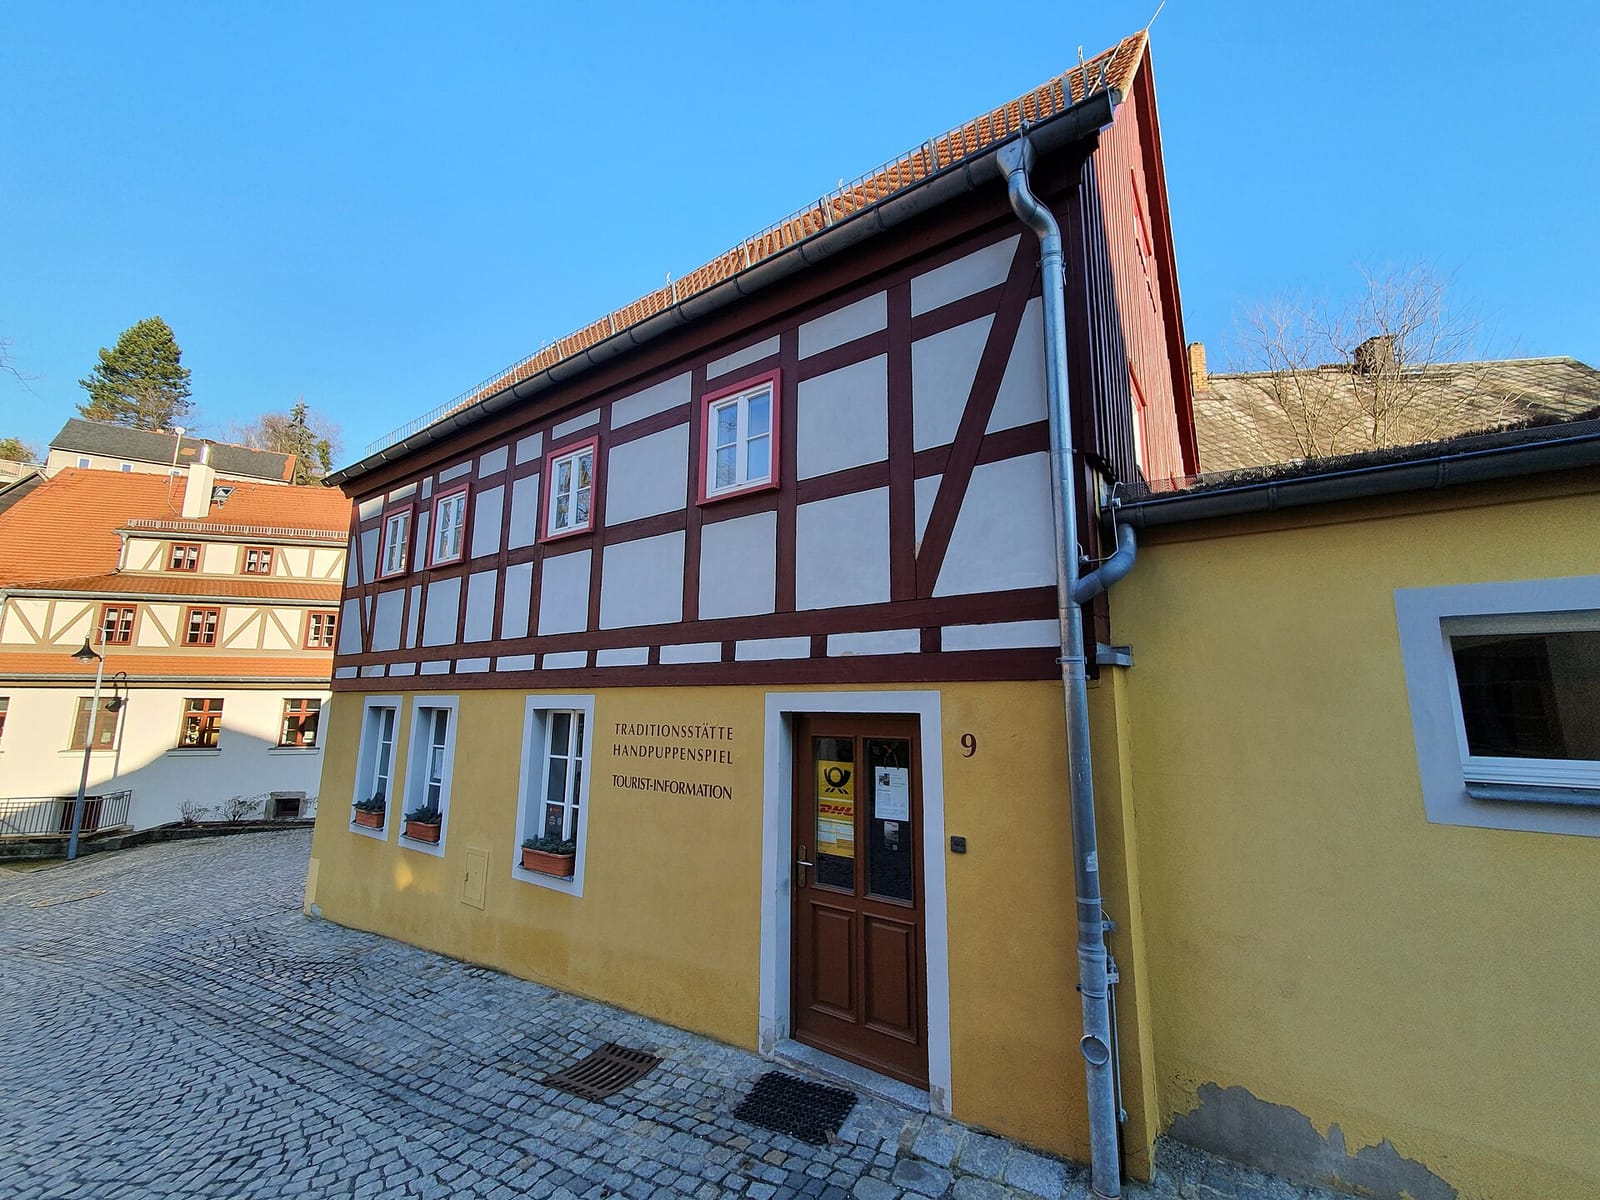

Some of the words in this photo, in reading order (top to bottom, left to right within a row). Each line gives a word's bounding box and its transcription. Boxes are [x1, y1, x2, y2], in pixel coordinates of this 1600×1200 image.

[615, 723, 734, 740] TRADITIONSSTÄTTE
[613, 744, 734, 764] HANDPUPPENSPIEL
[960, 733, 977, 758] 9
[612, 774, 733, 800] TOURIST-INFORMATION
[819, 804, 854, 816] DHL
